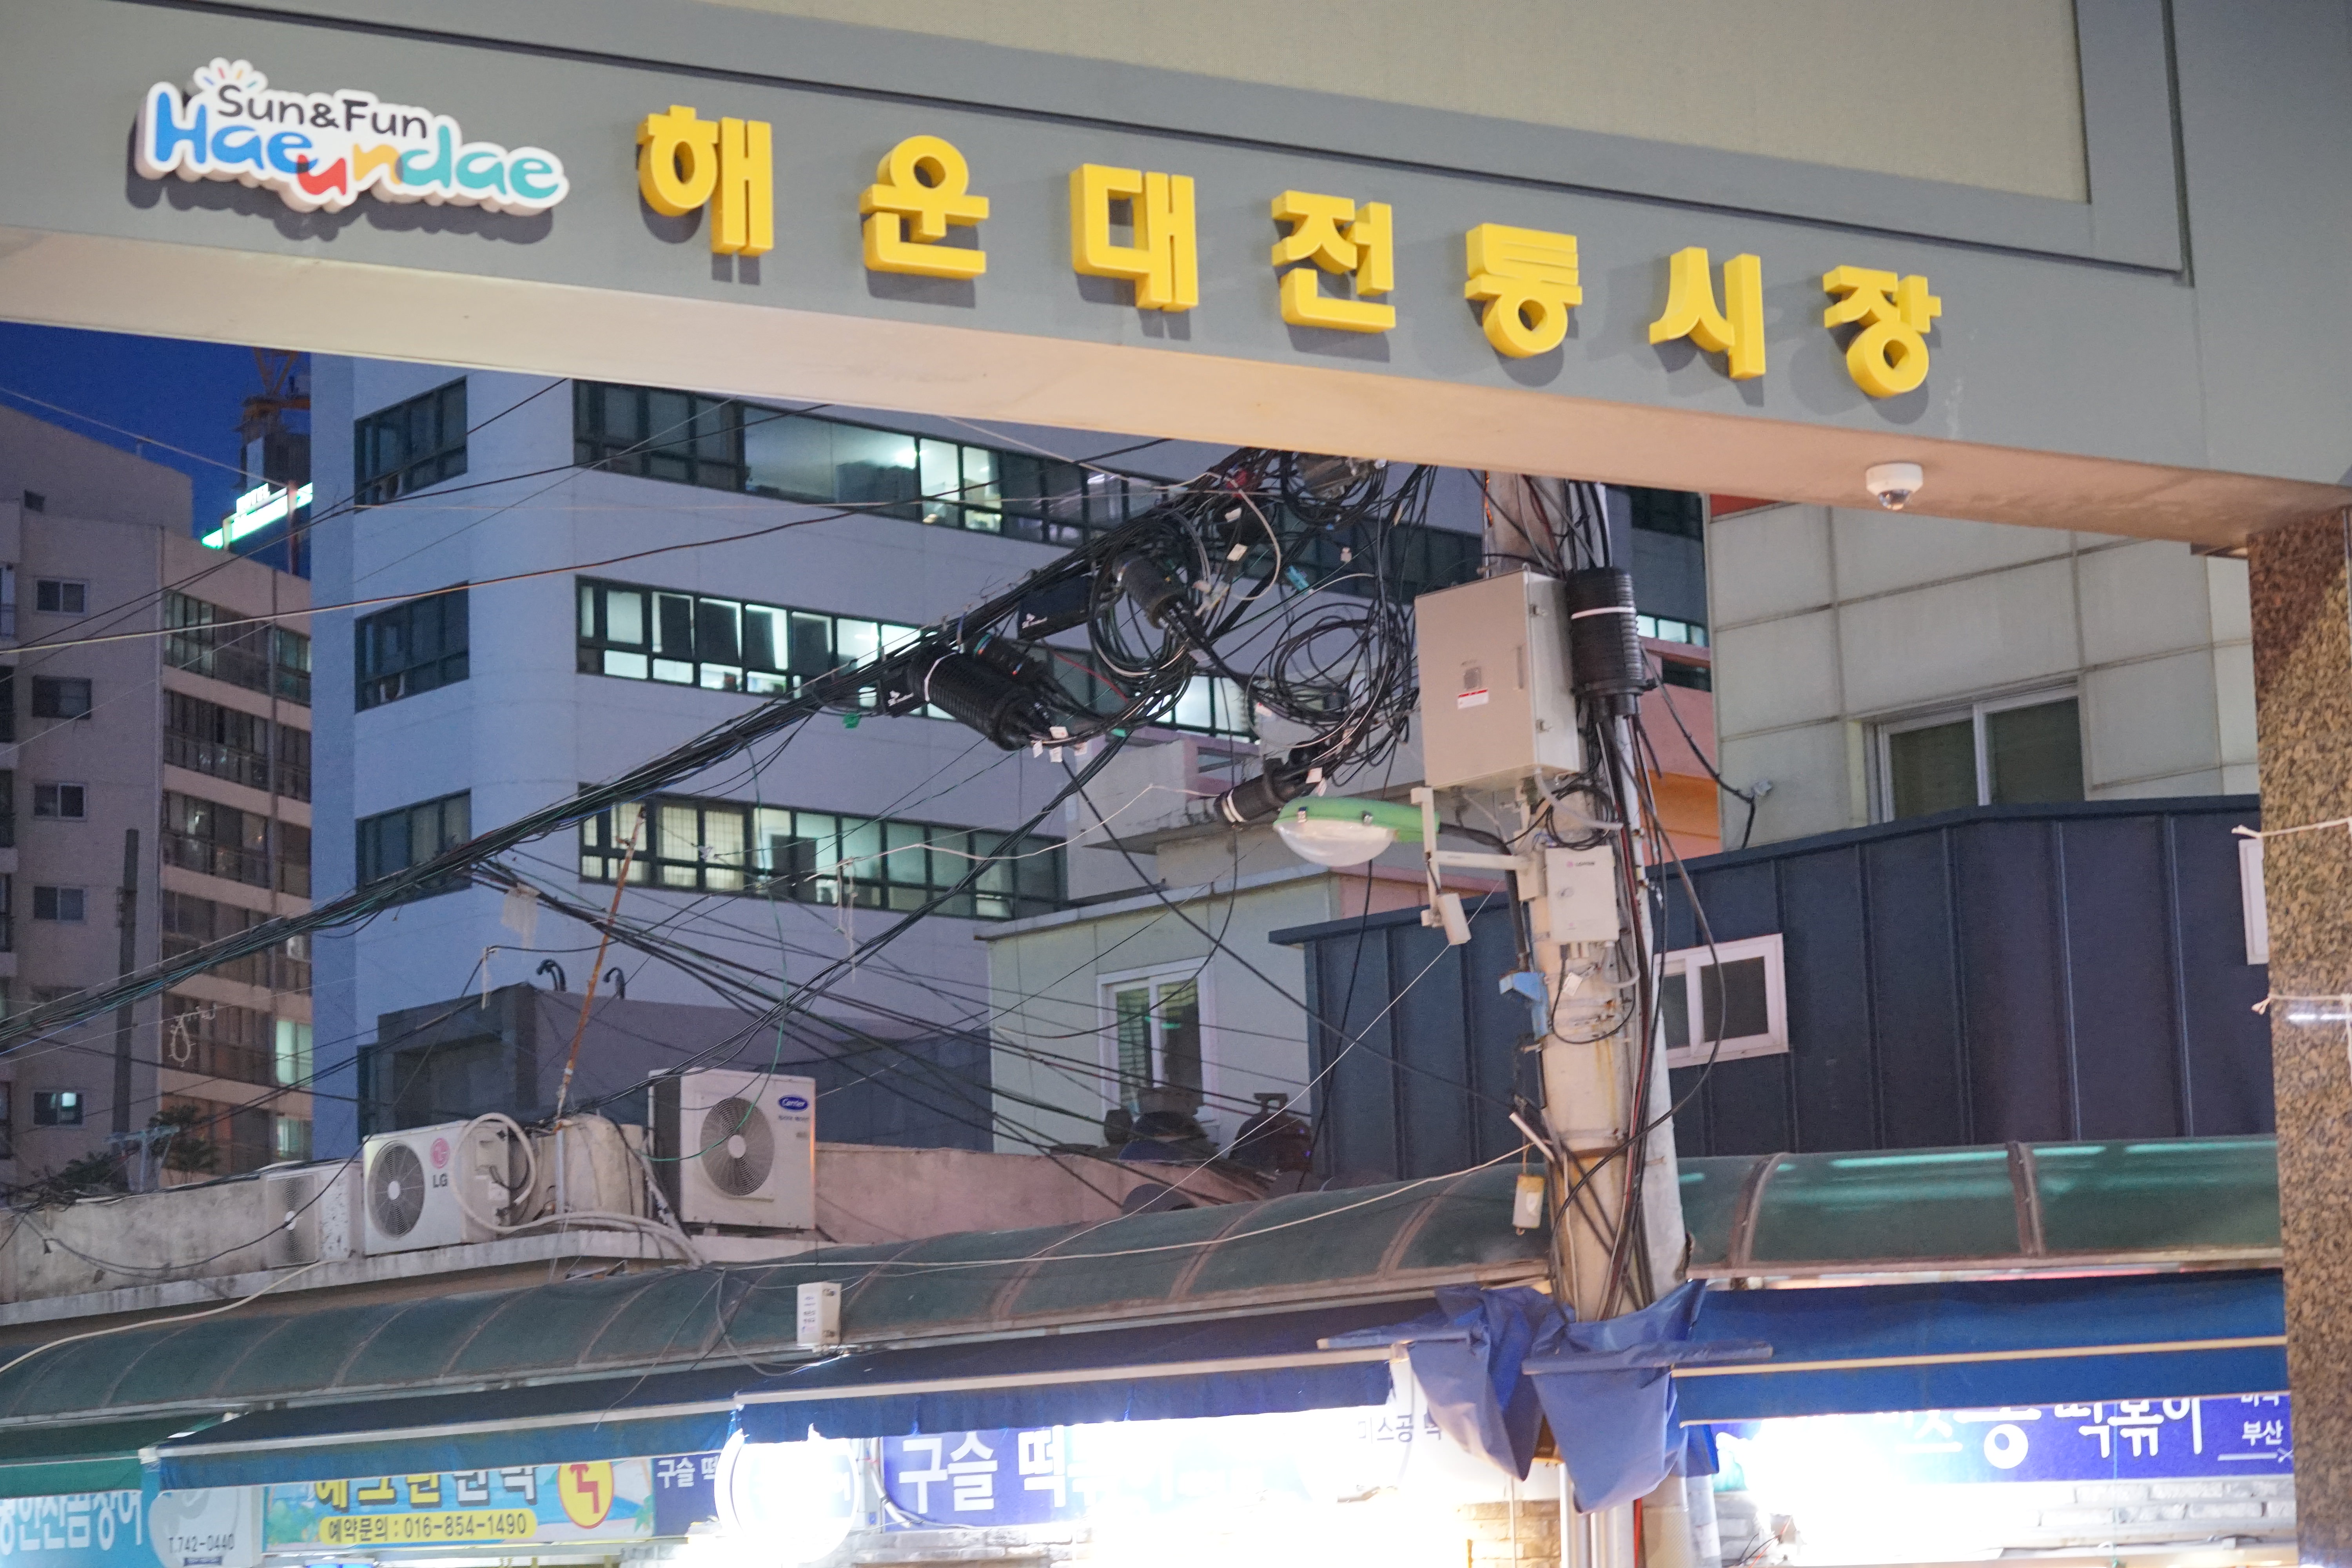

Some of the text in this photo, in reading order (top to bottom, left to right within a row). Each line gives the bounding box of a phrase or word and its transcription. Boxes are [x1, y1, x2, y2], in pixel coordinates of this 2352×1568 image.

[218, 83, 428, 140] Sun&Fun
[152, 92, 560, 200] Haeundae
[432, 1173, 448, 1188] LG
[2242, 1419, 2283, 1446] 부산
[657, 1457, 695, 1489] 구슬
[898, 1431, 998, 1514] 구슬
[329, 1515, 388, 1543] 예약문의
[404, 1512, 526, 1538] 016-854-1490
